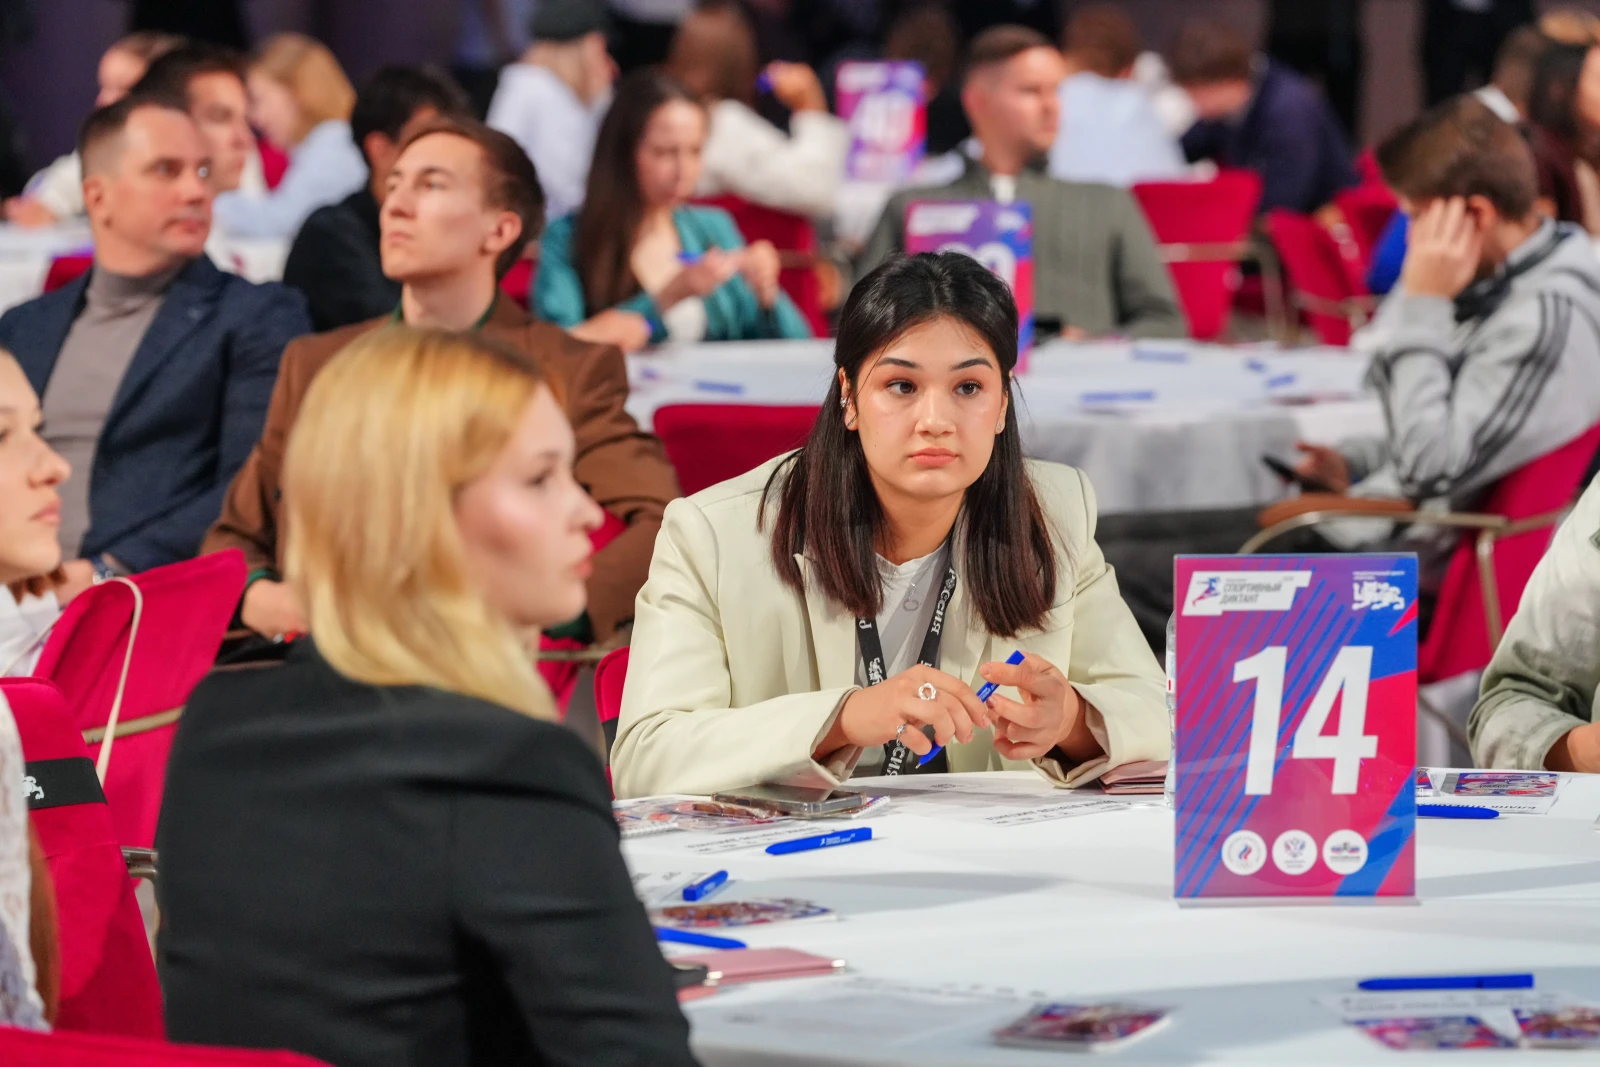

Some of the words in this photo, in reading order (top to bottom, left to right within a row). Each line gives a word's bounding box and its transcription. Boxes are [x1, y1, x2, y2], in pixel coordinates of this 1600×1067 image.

[1223, 581, 1282, 593] СПОРТИВНЫЙ
[1220, 593, 1259, 604] ДИКТАНТ
[1232, 645, 1379, 796] 14
